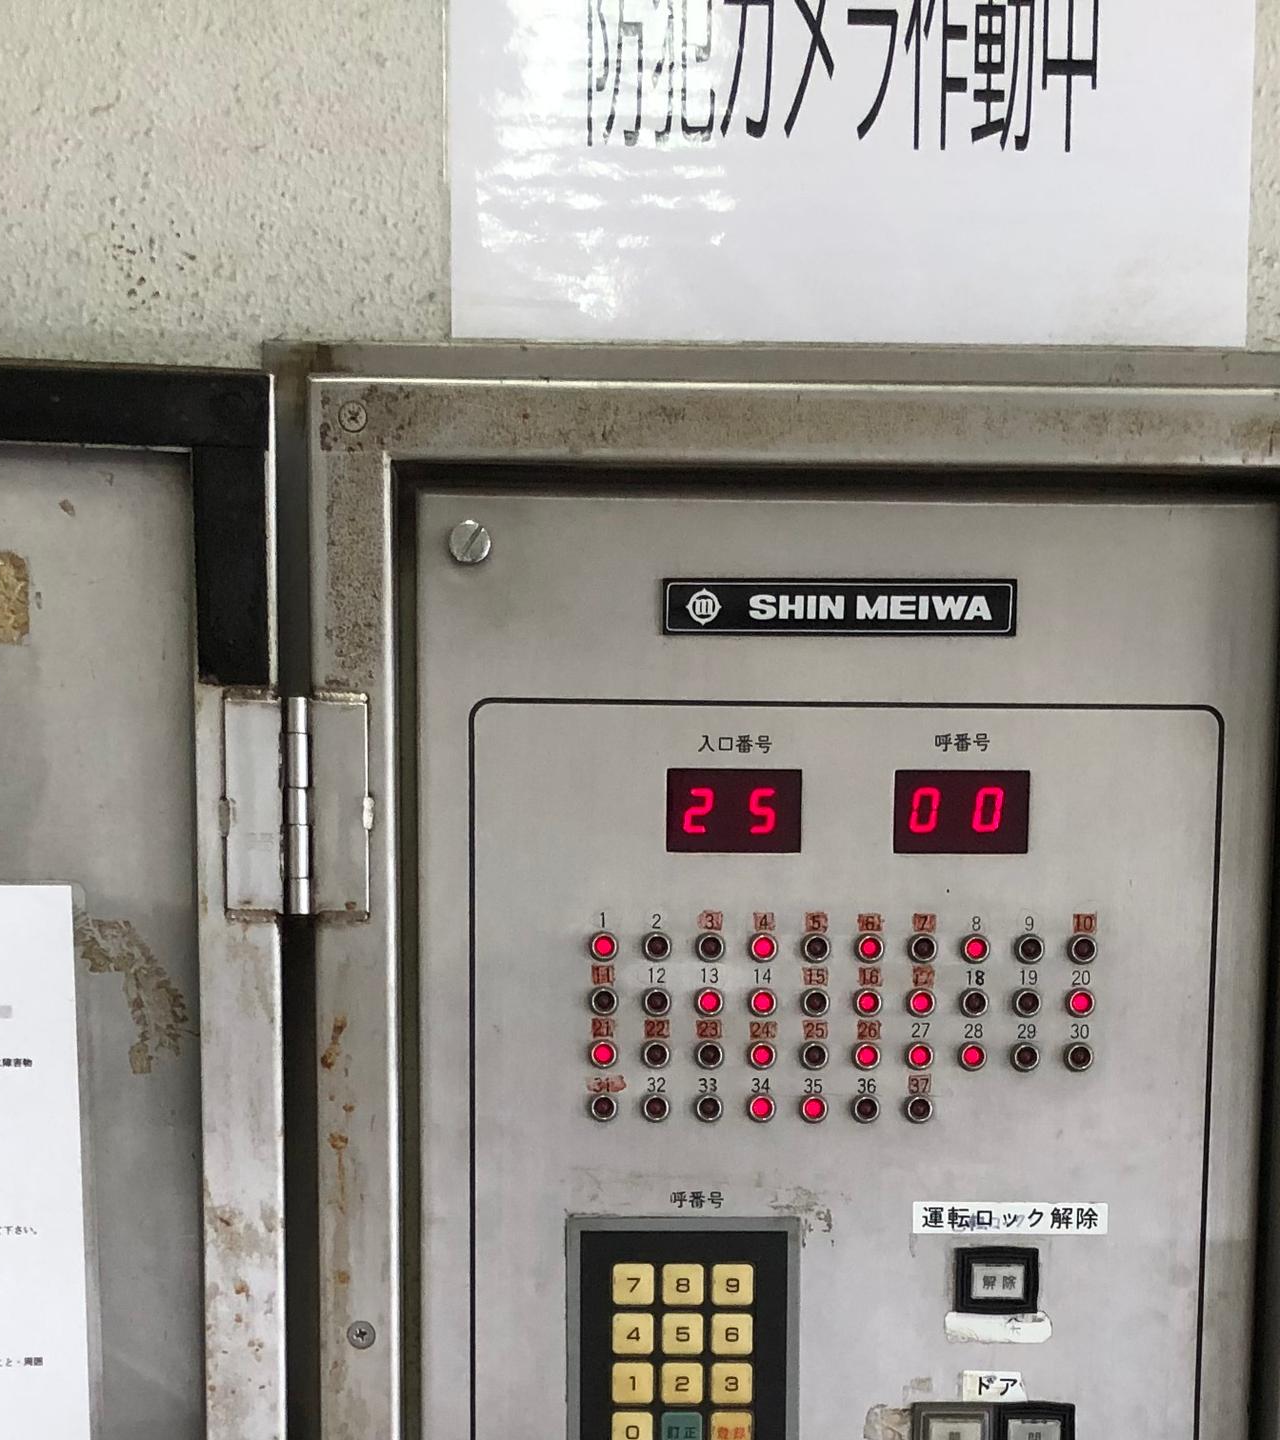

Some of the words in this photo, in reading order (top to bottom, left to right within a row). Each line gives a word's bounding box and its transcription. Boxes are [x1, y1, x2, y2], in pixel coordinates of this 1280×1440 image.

[749, 594, 846, 621] SHIN
[855, 595, 993, 621] MEIWA
[697, 734, 774, 755] 入口番号
[933, 733, 991, 753] 呼番号
[683, 787, 777, 835] 25
[908, 786, 1005, 834] 00
[599, 912, 607, 928] 1
[651, 913, 662, 929] 2
[704, 914, 715, 930] 3
[759, 914, 769, 930] 4
[919, 915, 929, 931] 7
[971, 916, 982, 931] 8
[1024, 916, 1035, 931] 9
[1074, 917, 1094, 931] 10
[648, 968, 666, 984] 12
[700, 968, 719, 984] 13
[753, 968, 771, 984] 14
[968, 970, 985, 986] 18
[1020, 970, 1038, 986] 19
[1071, 970, 1091, 986] 20
[593, 1020, 611, 1037] 21
[646, 1021, 666, 1037] 22
[699, 1021, 718, 1037] 23
[751, 1021, 771, 1038] 24
[806, 1022, 825, 1037] 25
[857, 1022, 878, 1038] 26
[911, 1023, 931, 1038] 27
[963, 1023, 983, 1038] 28
[1017, 1023, 1036, 1039] 29
[1070, 1024, 1090, 1039] 30
[647, 1077, 666, 1093] 32
[698, 1077, 718, 1093] 33
[751, 1077, 771, 1093] 34
[804, 1078, 823, 1094] 35
[856, 1078, 877, 1094] 36
[910, 1077, 929, 1093] 37
[670, 1191, 725, 1210] 呼番号
[921, 1206, 1099, 1230] 運転ロック解除
[626, 1277, 641, 1293] 7
[675, 1277, 690, 1293] 8
[725, 1277, 740, 1293] 9
[982, 1275, 1017, 1290] 解除
[626, 1326, 641, 1342] 4
[675, 1326, 690, 1342] 5
[725, 1326, 740, 1342] 6
[628, 1375, 637, 1391] 1
[675, 1375, 690, 1391] 2
[725, 1375, 740, 1391] 3
[977, 1376, 1018, 1396] ドア
[625, 1424, 640, 1440] 0
